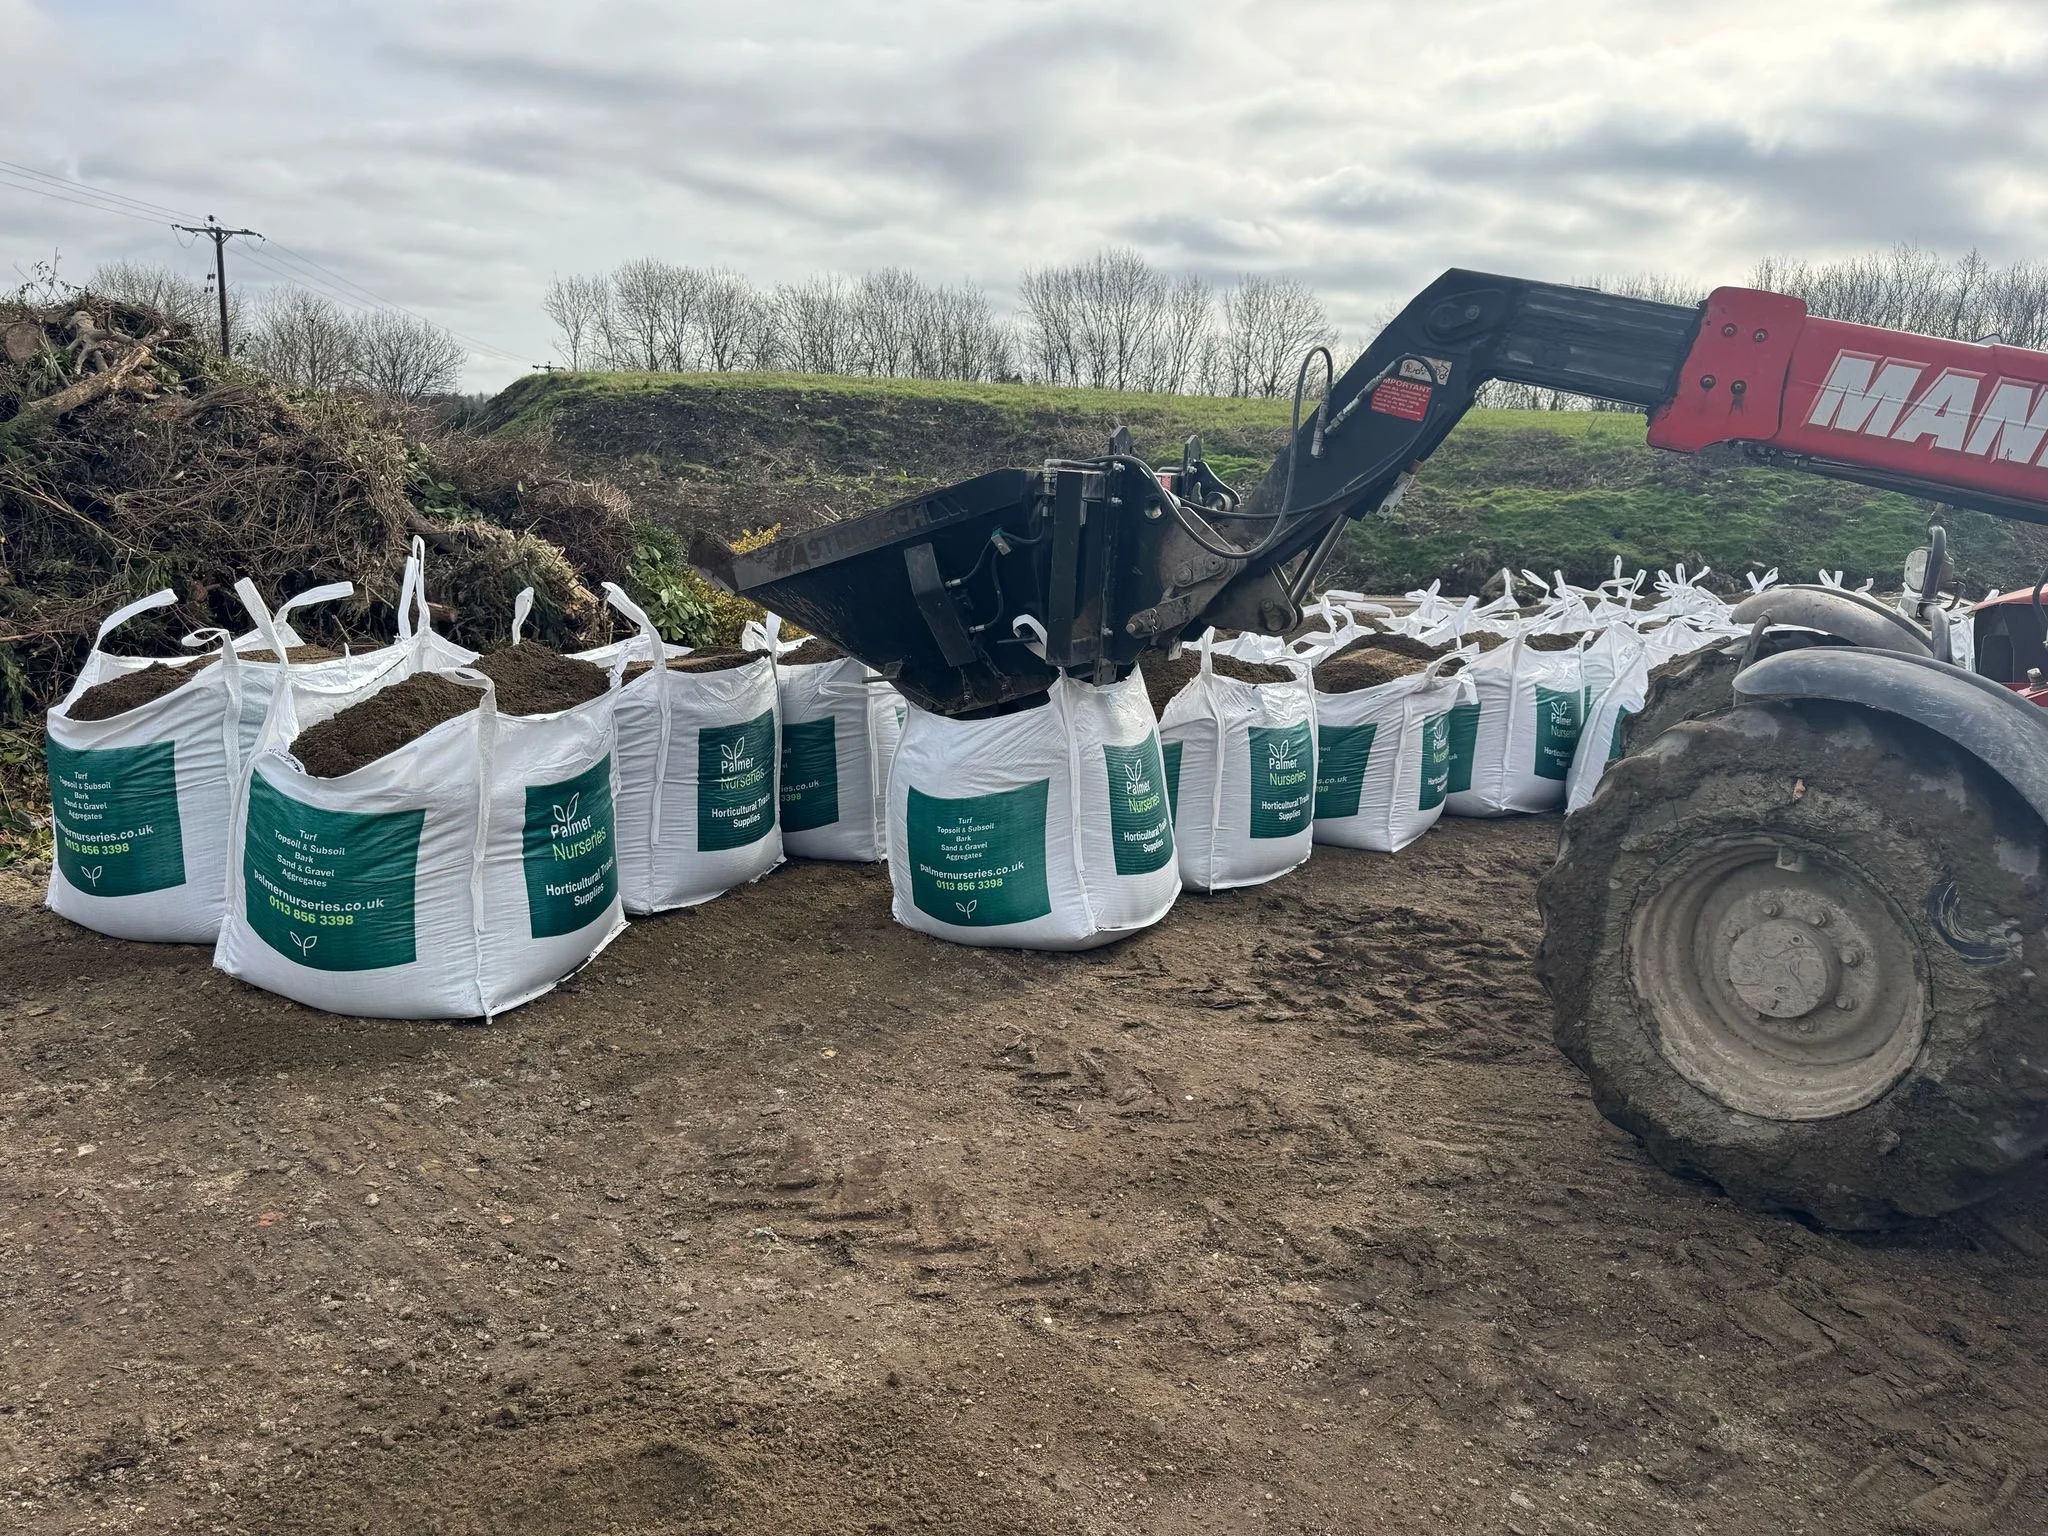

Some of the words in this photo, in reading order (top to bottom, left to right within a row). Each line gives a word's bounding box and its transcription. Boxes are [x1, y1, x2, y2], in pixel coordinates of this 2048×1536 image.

[1382, 378, 1431, 392] MPORTANT
[1801, 350, 2048, 468] MAN
[721, 757, 754, 774] Palmer
[1269, 757, 1298, 770] Palmer
[74, 772, 88, 780] Turf
[721, 768, 765, 790] Nurseries
[1269, 769, 1307, 786] Nurseries
[84, 781, 111, 790] Subsoil
[1126, 780, 1151, 795] Palmer
[74, 792, 89, 800] Bark
[83, 802, 108, 810] Gravel
[711, 801, 758, 818] Horticultural
[1261, 798, 1299, 810] Horticultural
[68, 810, 103, 821] Aggregates
[733, 813, 761, 828] Supplies
[1278, 809, 1301, 821] Supplies
[550, 815, 591, 839] Palmer
[936, 825, 960, 834] Topsoil
[968, 823, 994, 833] Subsoil
[274, 829, 301, 849] Topsoil
[302, 843, 308, 851] &
[310, 845, 345, 856] Subsoil
[299, 829, 318, 842] Turf
[81, 843, 100, 855] 856
[102, 842, 129, 855] 3398
[552, 826, 607, 862] Nurseries
[965, 842, 988, 851] Gravel
[294, 851, 314, 864] Bark
[945, 852, 982, 862] Aggregates
[277, 854, 296, 870] Sand
[304, 866, 335, 877] Gravel
[920, 860, 1025, 880] palmernurseries.co.uk
[281, 868, 327, 888] Aggregates
[545, 868, 600, 896] Horticultural
[936, 880, 955, 890] 0113
[957, 881, 975, 891] 856
[977, 878, 1003, 890] 3398
[254, 869, 385, 912] palmernurseries.co.uk
[574, 883, 604, 906] Supplies
[269, 895, 291, 916] 0113
[293, 909, 316, 924] 856
[320, 915, 354, 926] 3398
